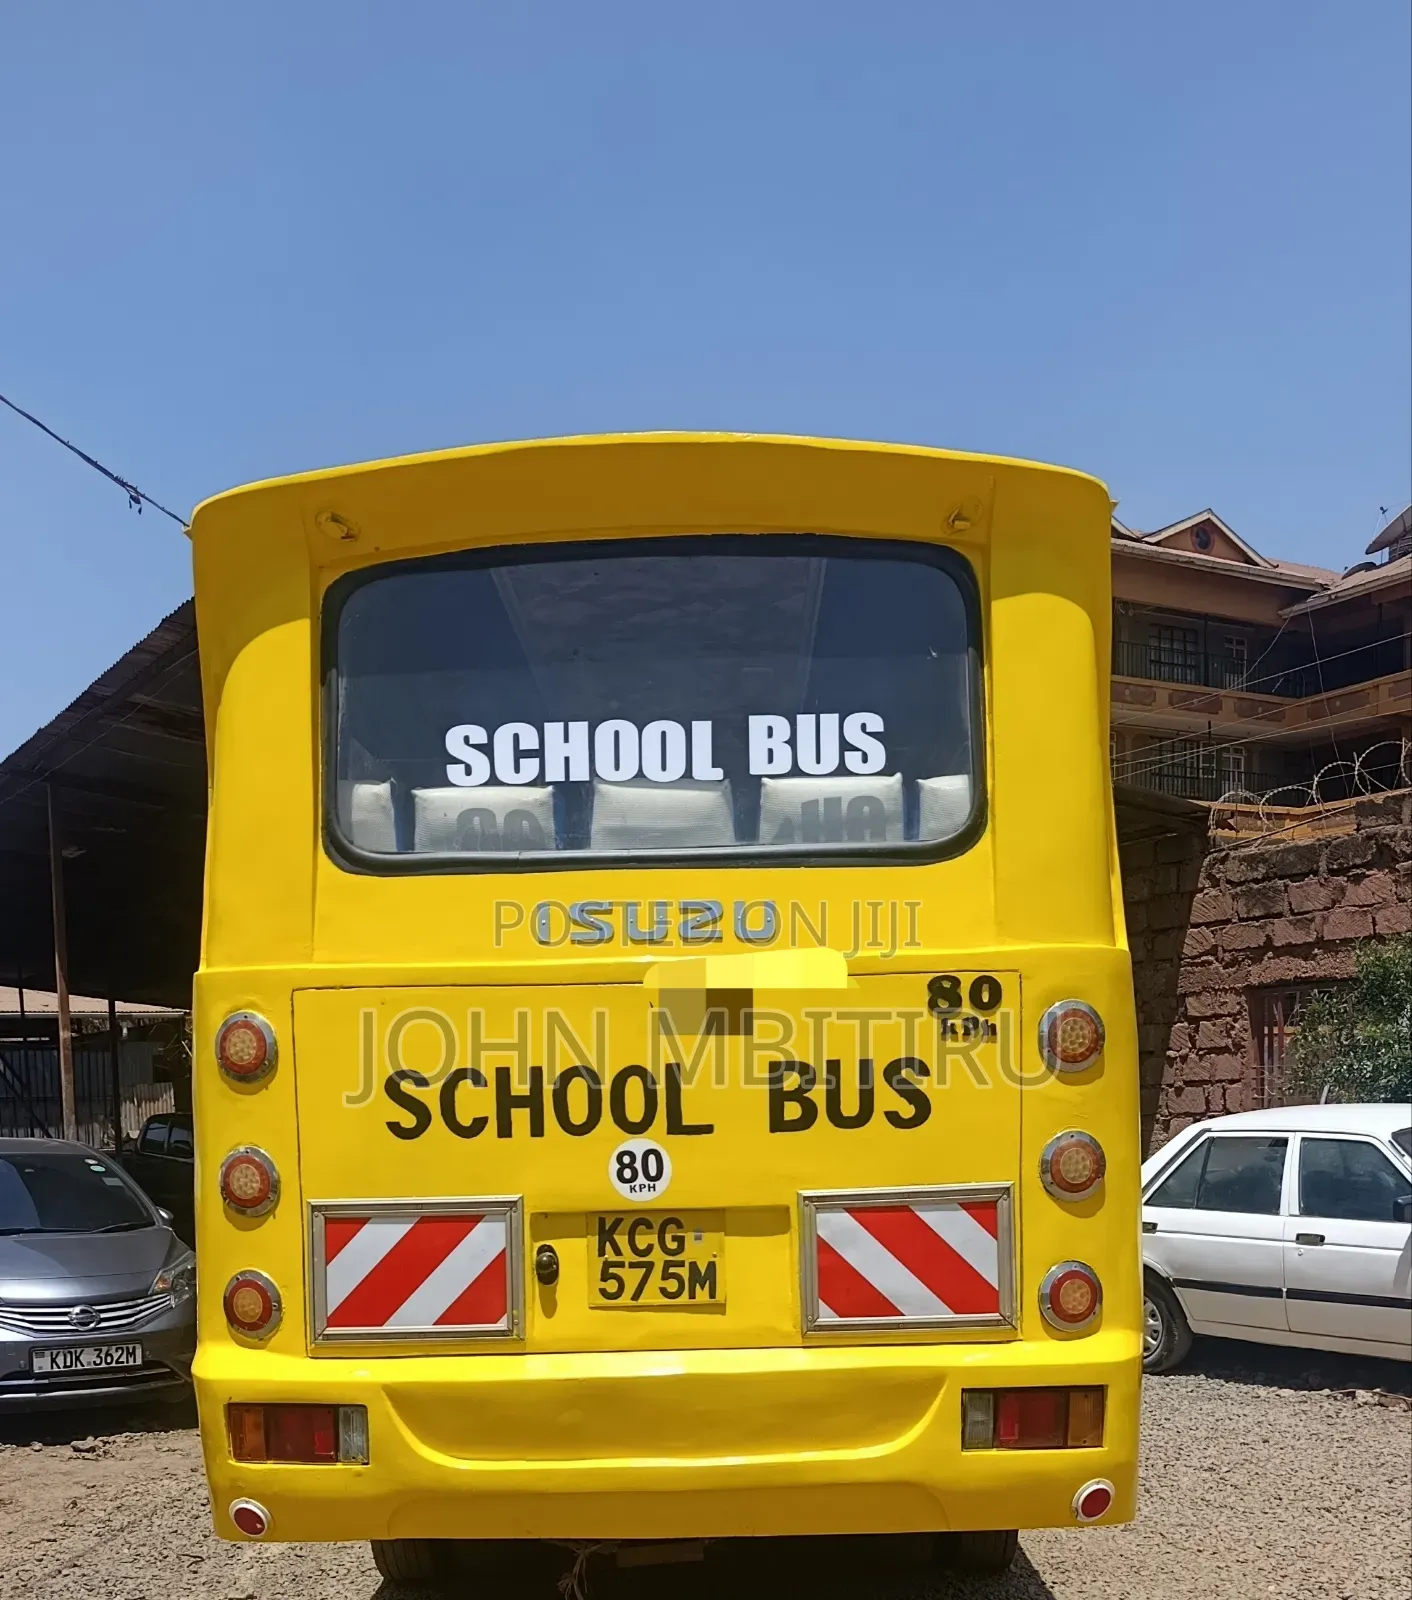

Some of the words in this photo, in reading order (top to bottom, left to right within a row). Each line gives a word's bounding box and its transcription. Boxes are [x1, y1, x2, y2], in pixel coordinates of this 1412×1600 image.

[444, 719, 725, 788] SCHOOL
[748, 711, 887, 776] BUS
[536, 901, 777, 945] ISUZU
[927, 974, 1002, 1014] 80
[383, 1064, 715, 1141] SCHOOL
[768, 1056, 933, 1134] BUS
[615, 1148, 665, 1184] 80
[629, 1183, 657, 1194] KPH
[597, 1216, 687, 1258] KCG
[598, 1259, 718, 1302] 575M
[49, 1349, 86, 1370] KDK
[92, 1345, 137, 1366] 362M
